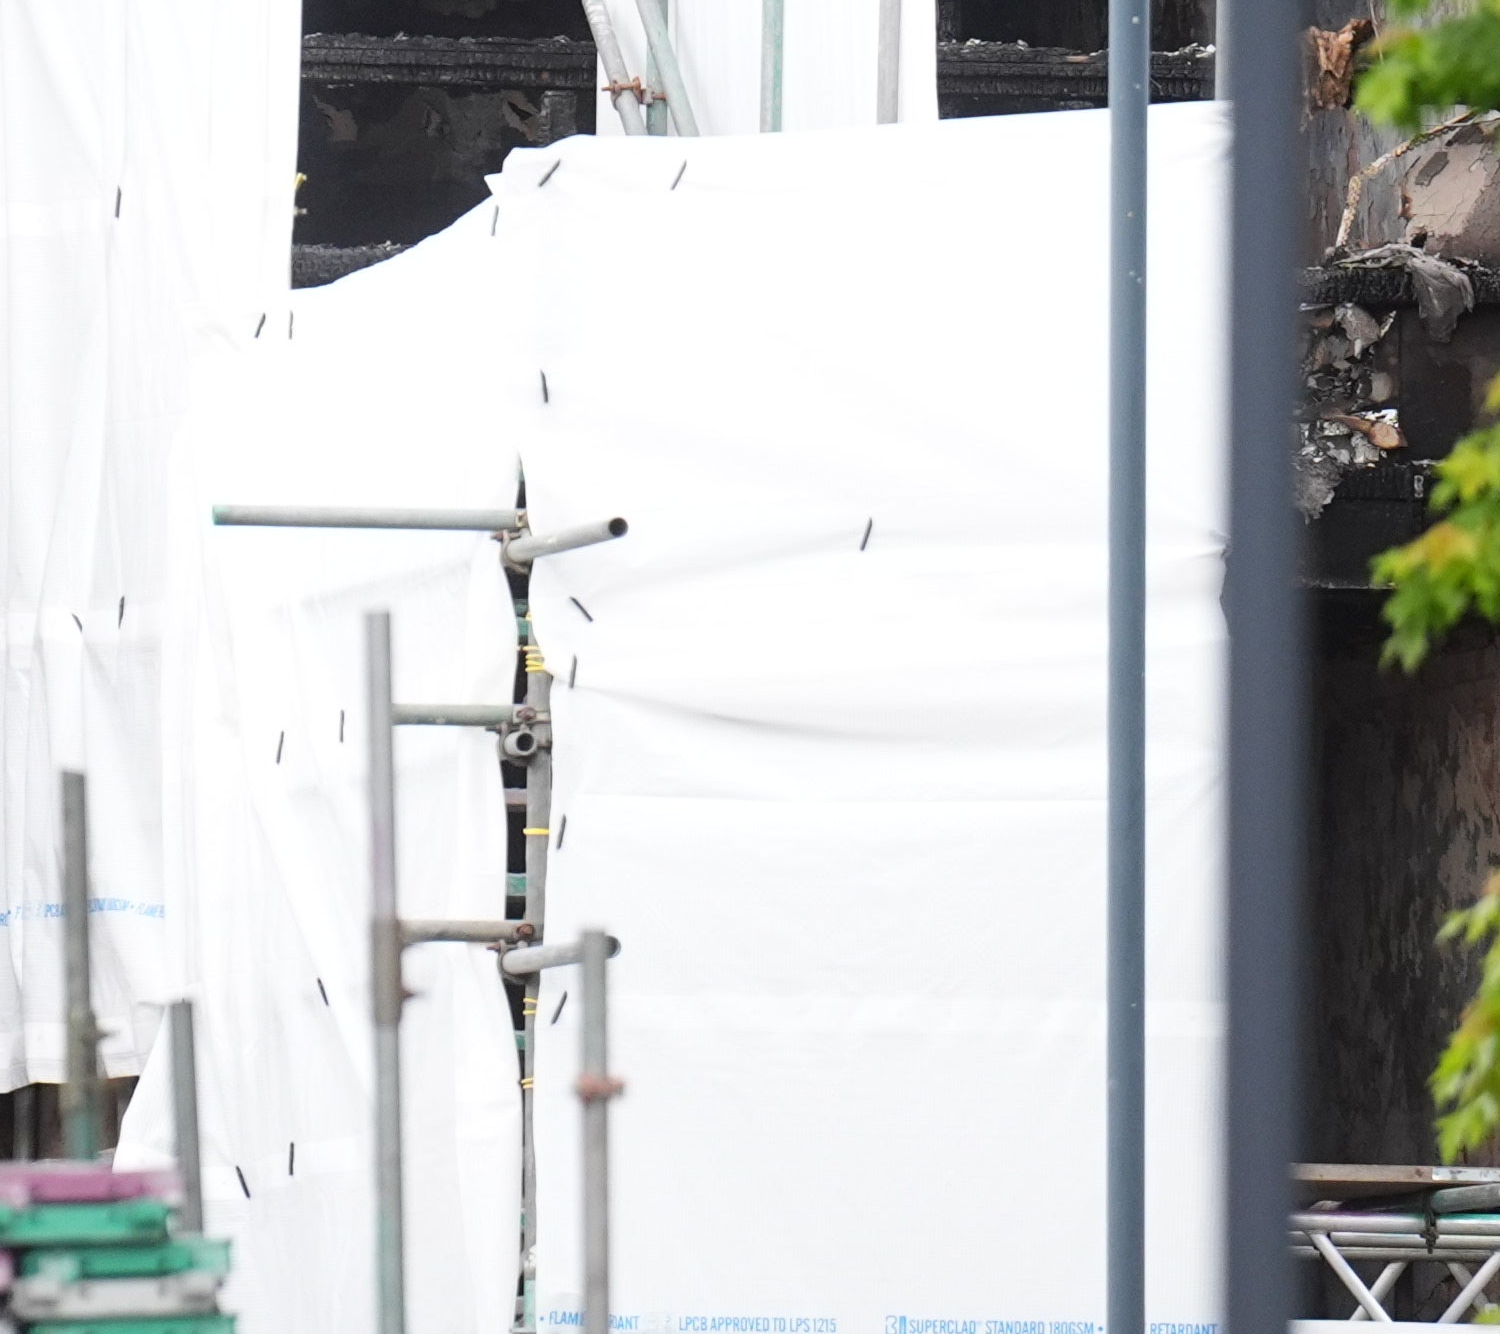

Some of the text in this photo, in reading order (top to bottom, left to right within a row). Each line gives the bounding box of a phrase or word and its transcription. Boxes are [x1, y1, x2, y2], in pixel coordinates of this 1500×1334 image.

[679, 1316, 707, 1331] LPCB
[710, 1317, 769, 1332] APPROVED
[773, 1317, 786, 1332] TO
[789, 1318, 810, 1333] LPS
[812, 1318, 837, 1333] 1215
